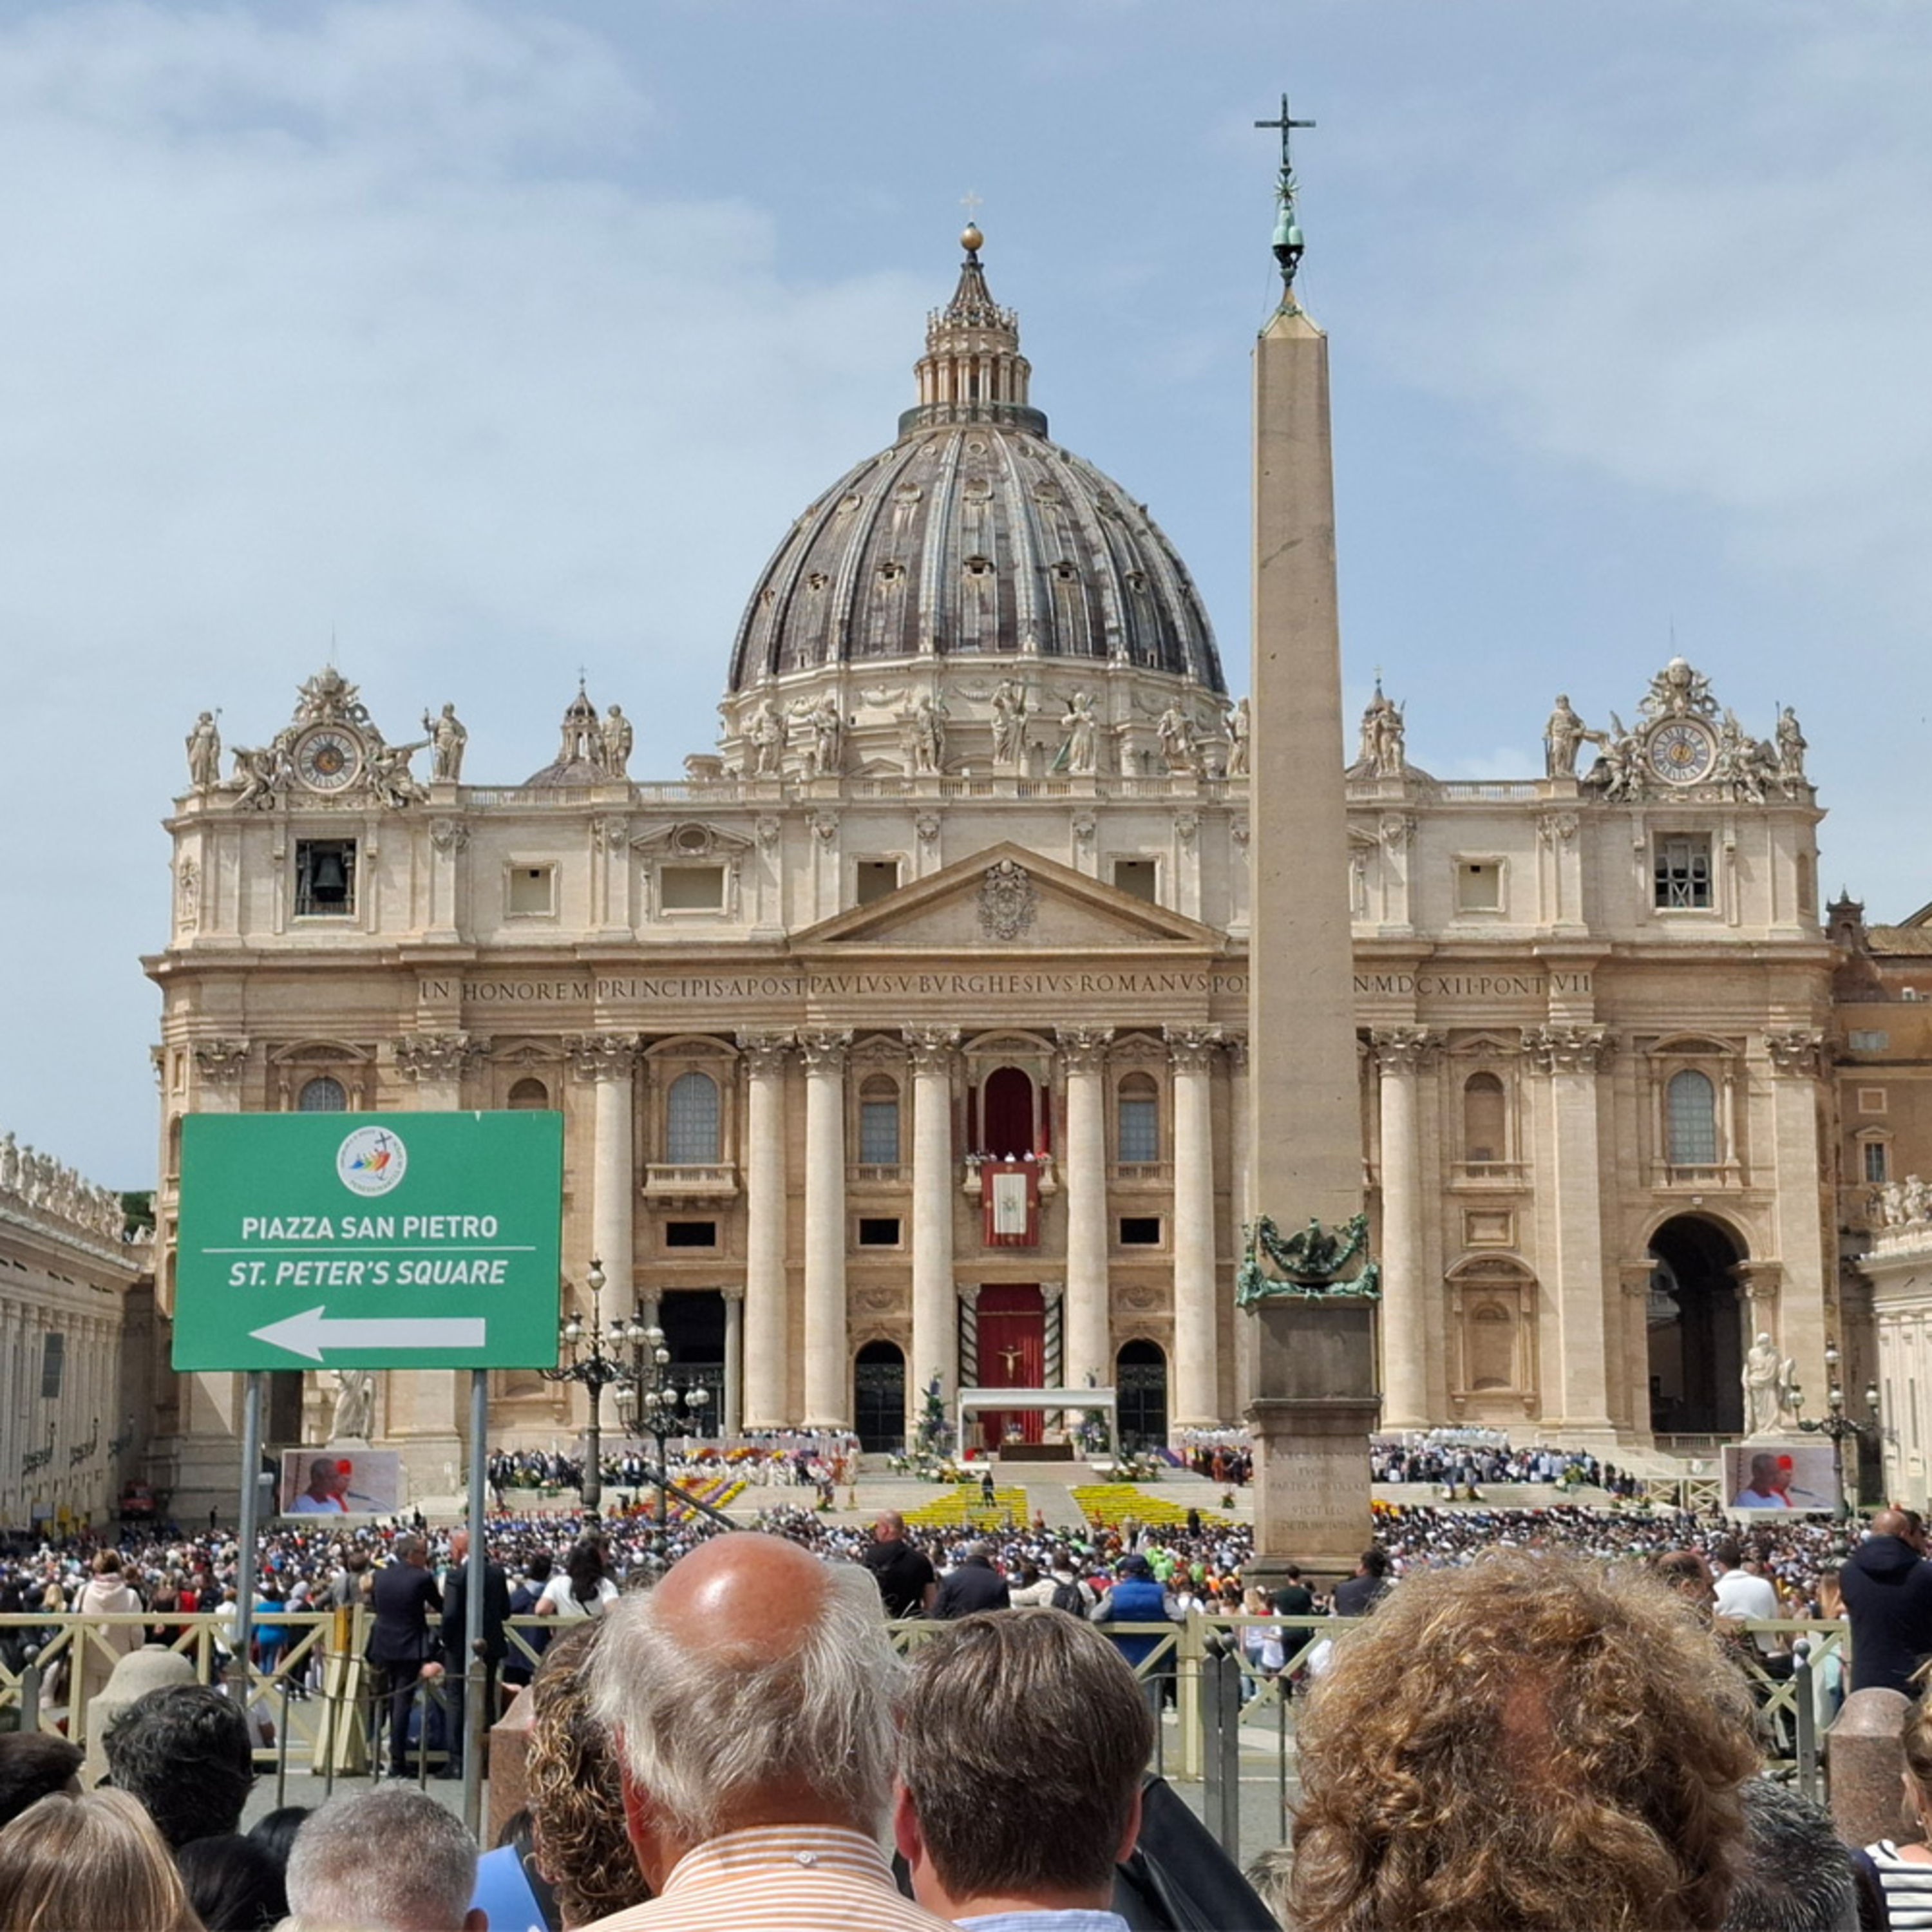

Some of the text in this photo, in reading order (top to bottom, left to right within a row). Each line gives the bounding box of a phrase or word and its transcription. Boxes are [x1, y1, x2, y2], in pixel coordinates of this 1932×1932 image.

[421, 980, 450, 999] IN
[462, 982, 590, 1001] HONOREM
[596, 979, 724, 998] PRINCIPIS
[728, 977, 806, 996] APOST
[810, 975, 894, 994] PAVLVS
[919, 974, 1075, 993] BVRGHESIVS
[1081, 974, 1207, 992] ROMANVS
[1481, 976, 1545, 994] PONT
[1553, 974, 1590, 993] VII
[242, 1215, 498, 1240] PIAZZA SAN PIETRO
[228, 1259, 508, 1287] ST. PETER'S SQUARE
